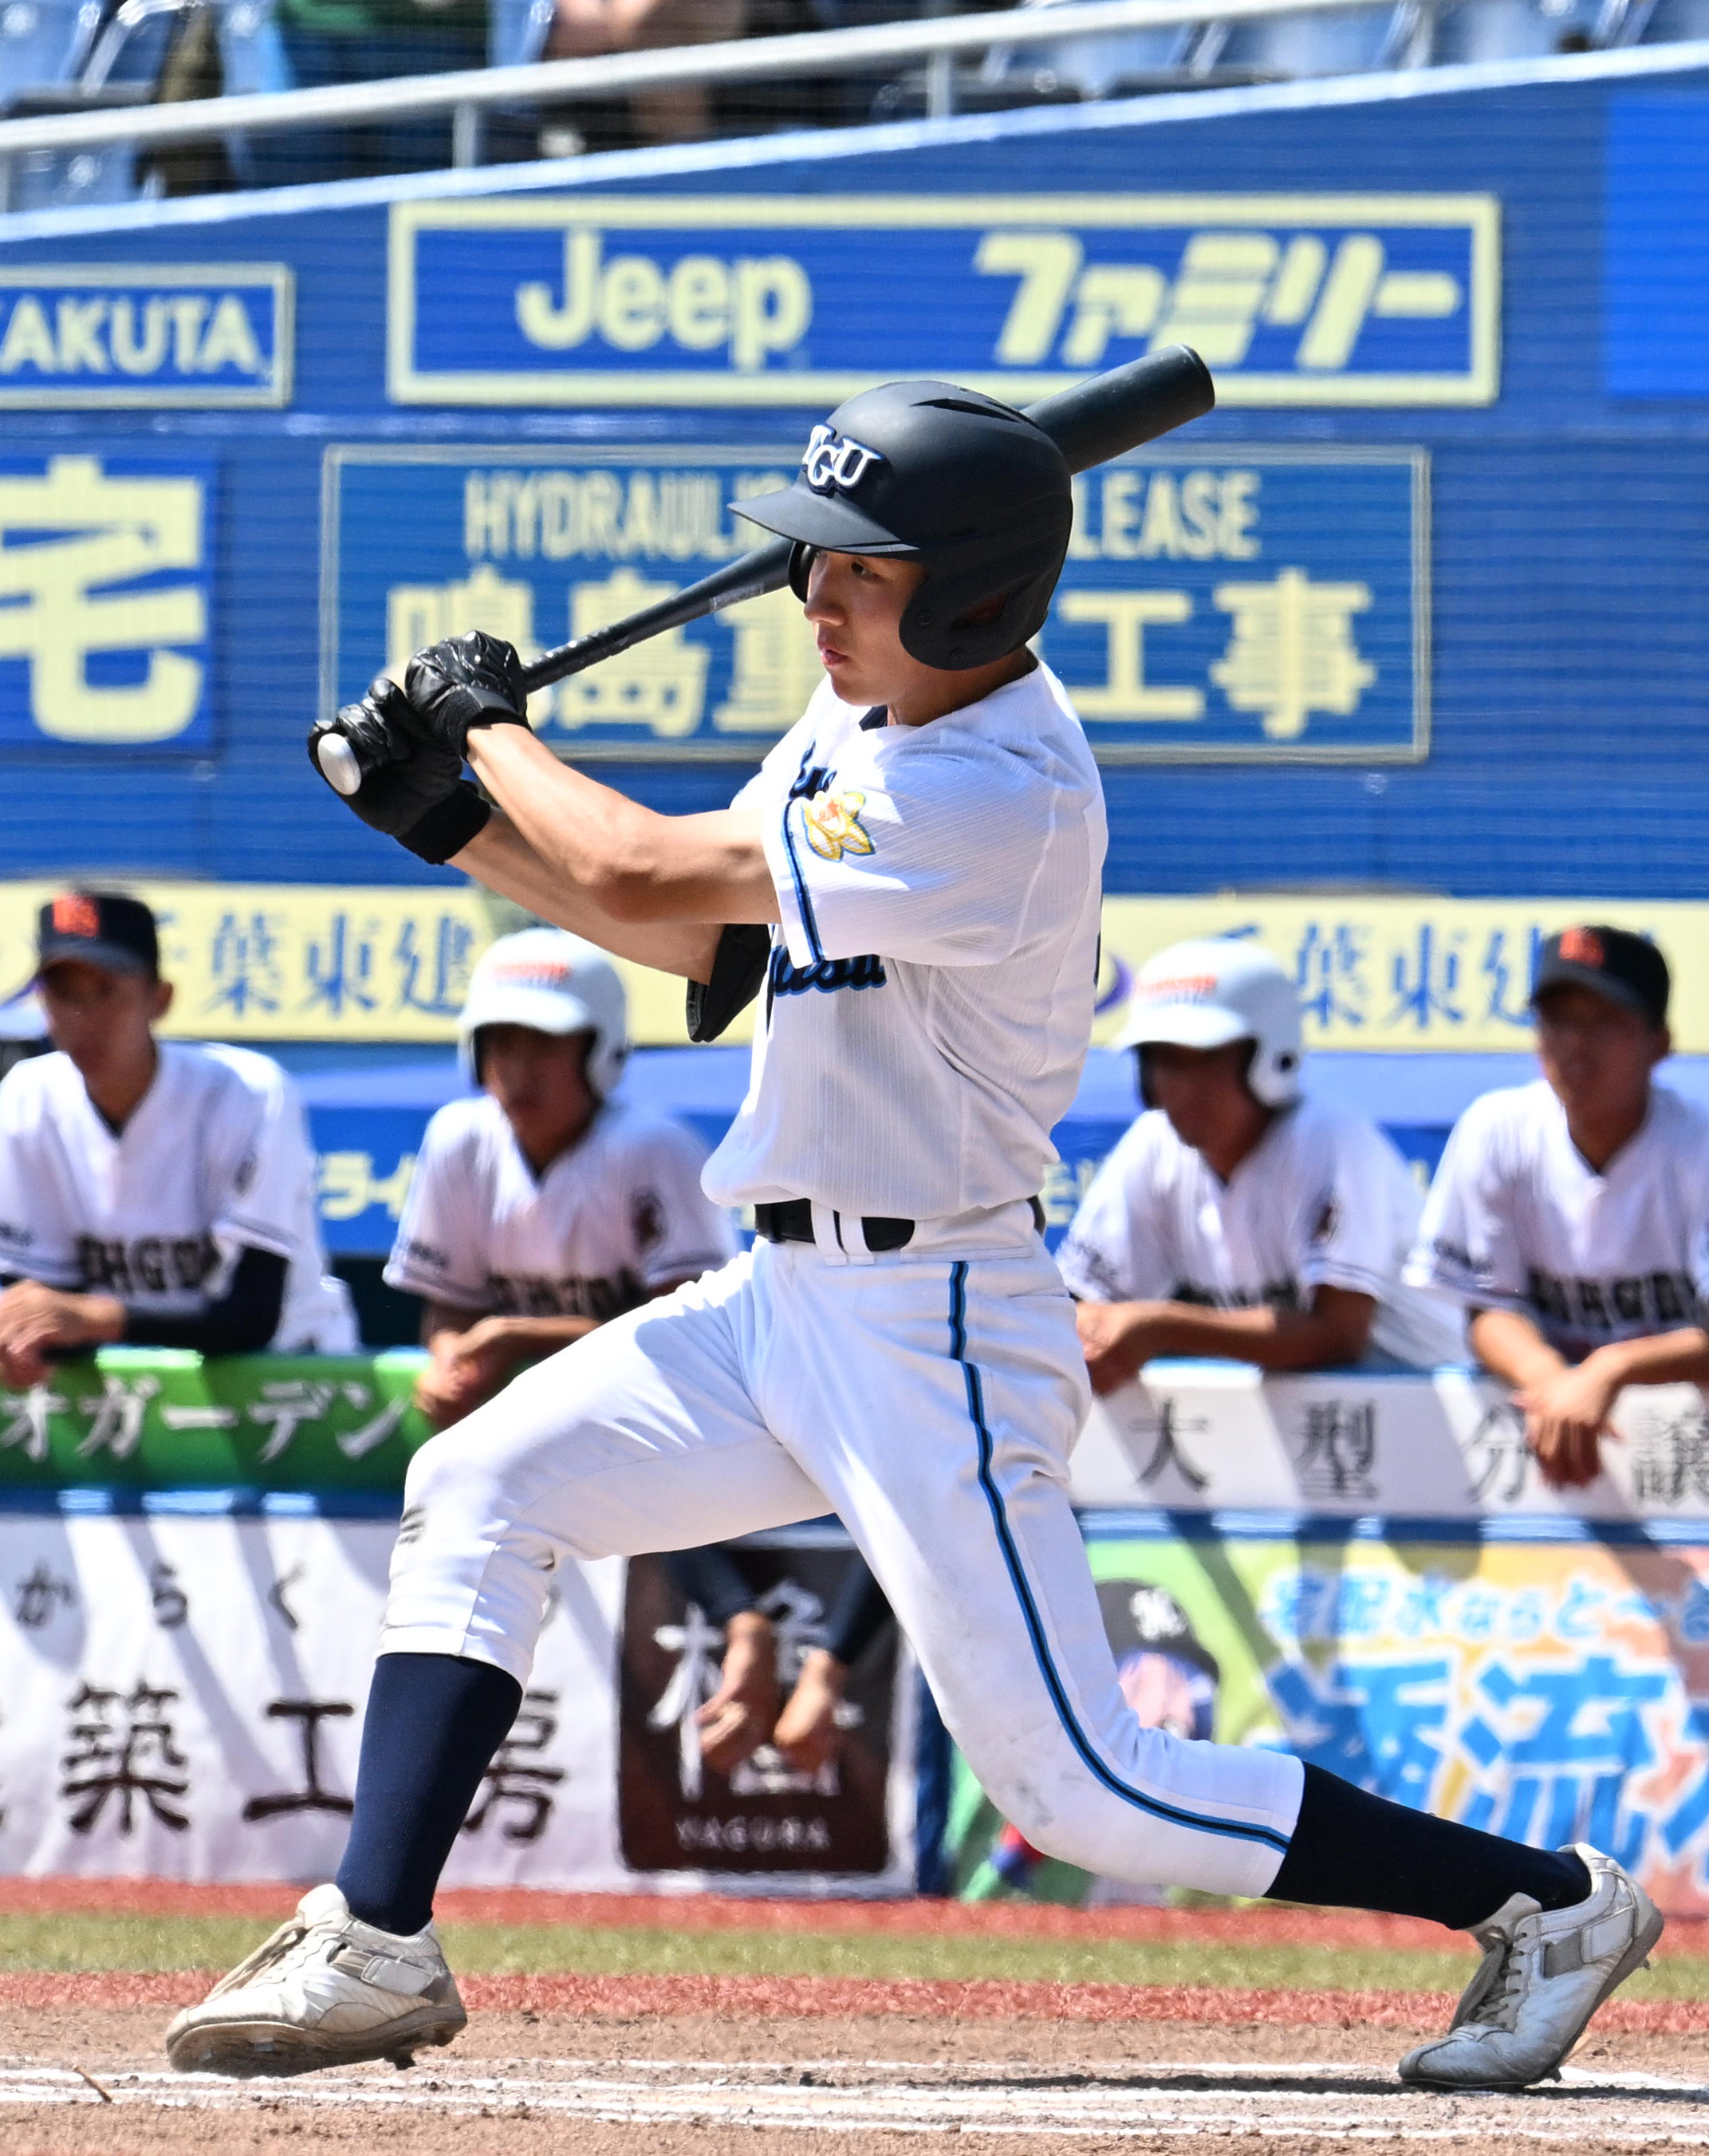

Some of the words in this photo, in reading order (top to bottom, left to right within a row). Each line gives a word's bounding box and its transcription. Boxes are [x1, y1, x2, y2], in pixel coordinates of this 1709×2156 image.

[515, 228, 813, 371] Jeep
[975, 231, 1461, 369] ファミリー
[0, 1679, 565, 1847] 築工房
